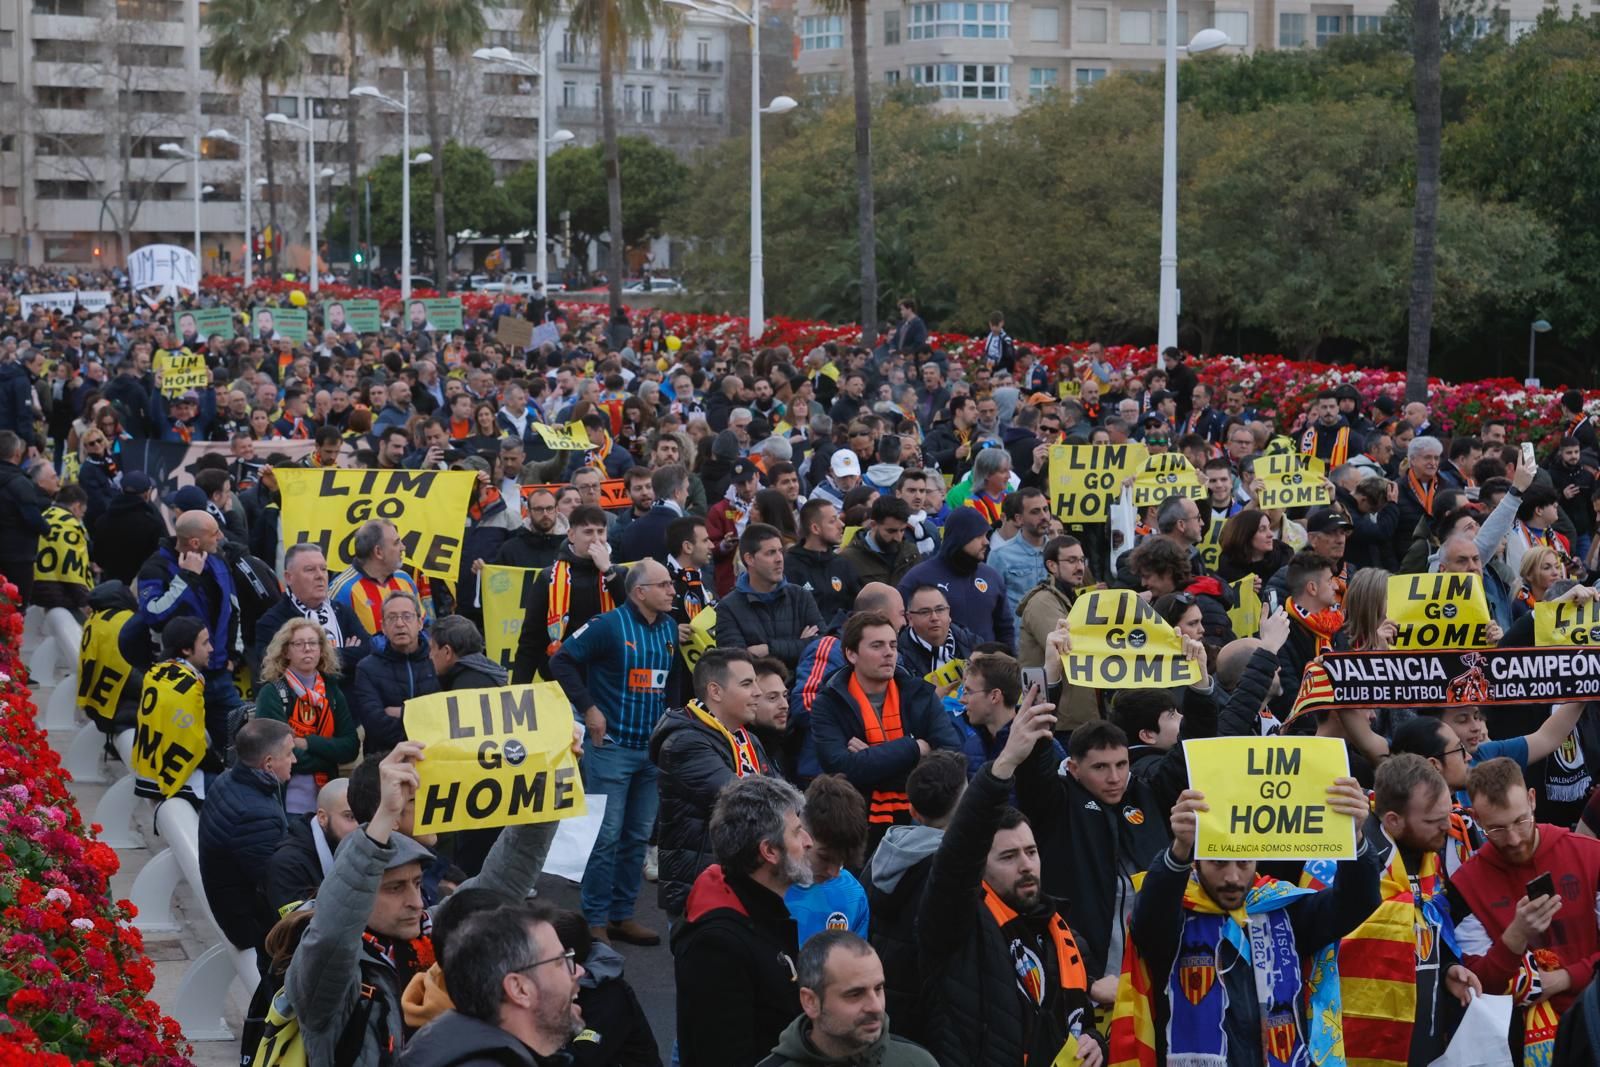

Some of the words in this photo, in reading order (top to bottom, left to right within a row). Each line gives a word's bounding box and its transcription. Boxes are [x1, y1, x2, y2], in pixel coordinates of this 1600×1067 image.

[171, 356, 198, 368] LIM
[164, 374, 206, 386] HOME
[1069, 445, 1127, 470] LIM
[1145, 454, 1187, 472] LIM
[1270, 455, 1311, 474] LIM
[320, 470, 438, 499] LIM
[1084, 472, 1115, 490] GO
[1135, 485, 1201, 503] HOME
[1262, 486, 1325, 506] HOME
[346, 497, 405, 525] GO
[1408, 575, 1474, 601] LIM
[1086, 592, 1164, 626] LIM
[1393, 623, 1488, 647] HOME
[633, 673, 649, 684] TM
[1069, 653, 1192, 684] HOME
[1322, 656, 1448, 682] VALENCIA
[1333, 686, 1370, 701] CLUB
[1373, 686, 1392, 701] DE
[1394, 685, 1447, 701] FUTBOL
[1495, 684, 1527, 699] LIGA
[1529, 681, 1562, 698] 2001
[1576, 679, 1600, 695] 200
[446, 688, 538, 740] LIM
[1247, 747, 1302, 776] LIM
[1259, 780, 1292, 800] GO
[1549, 774, 1577, 784] VALENCIA
[421, 766, 576, 826] HOME
[1230, 805, 1326, 835] HOME
[1207, 843, 1217, 852] EL
[1220, 843, 1259, 852] VALENCIA
[1261, 844, 1292, 853] SOMOS
[1294, 843, 1343, 853] NOSOTROS
[1274, 921, 1292, 967] VISCA
